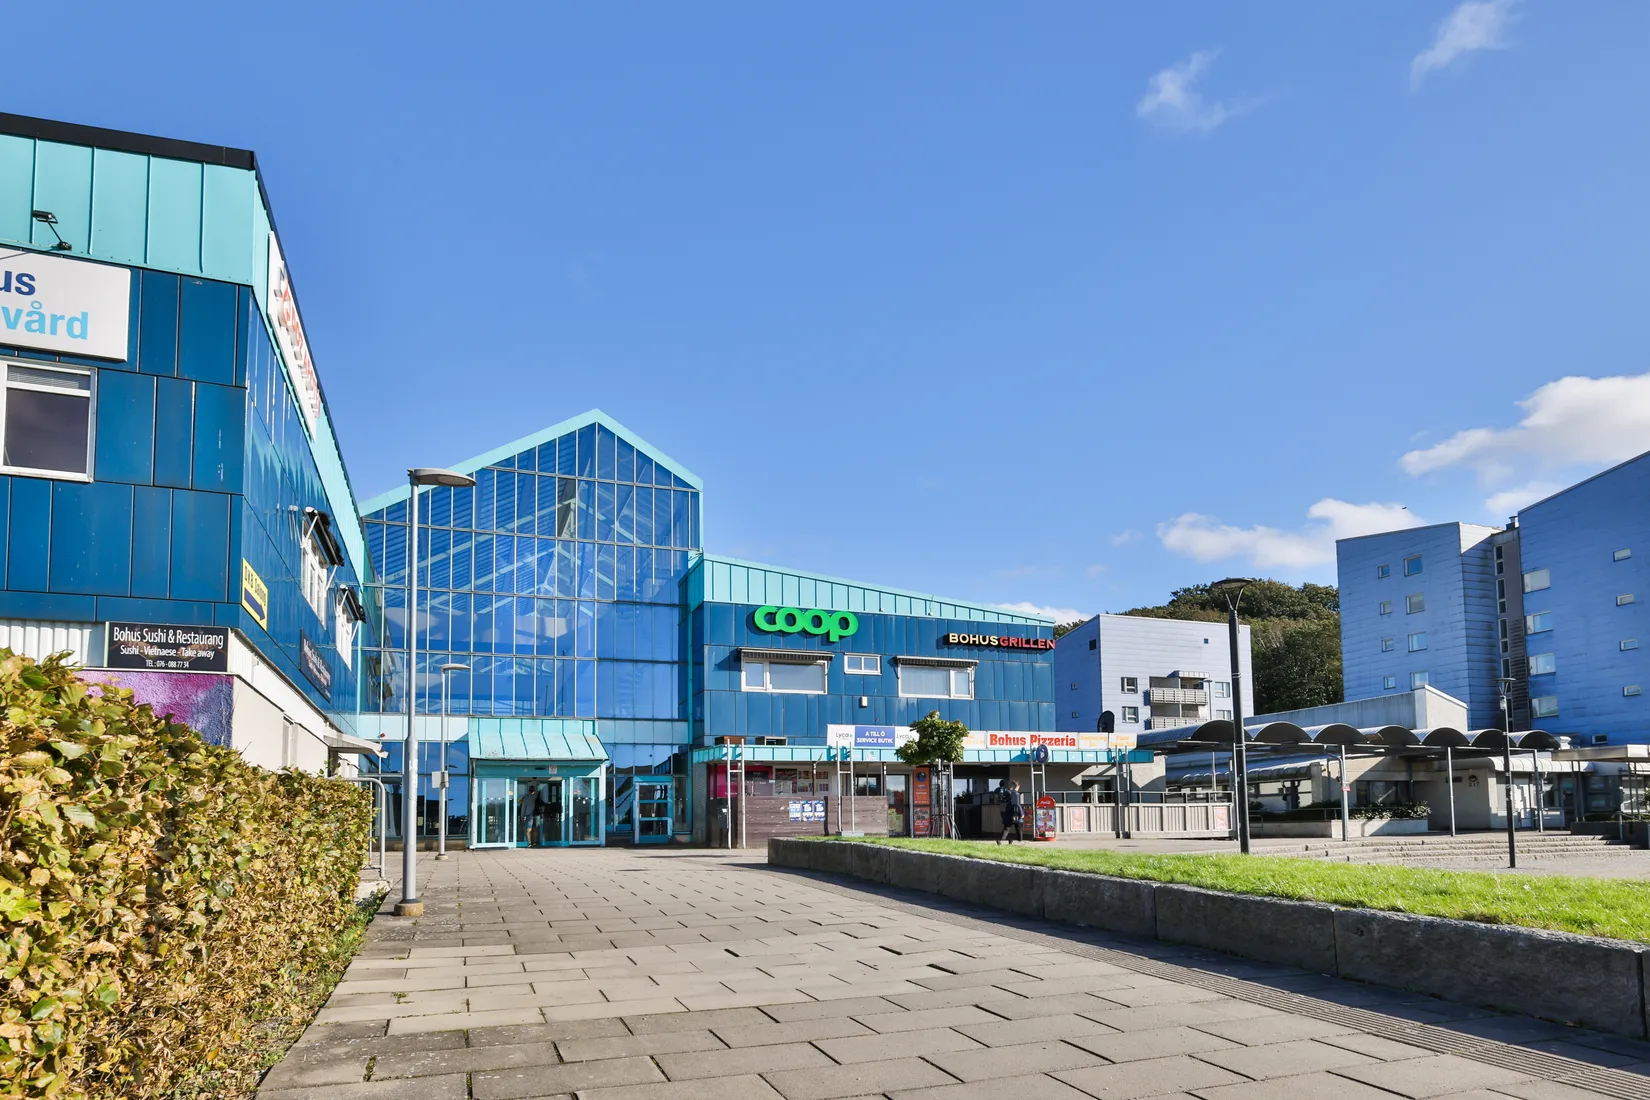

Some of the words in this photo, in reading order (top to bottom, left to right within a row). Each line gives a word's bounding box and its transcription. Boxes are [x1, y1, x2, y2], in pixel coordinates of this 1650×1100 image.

[1, 300, 89, 340] vård
[754, 605, 859, 642] coop
[113, 626, 141, 642] Bohus
[143, 627, 167, 643] Sushi
[167, 630, 175, 643] &
[176, 629, 224, 649] Restaurang
[120, 644, 139, 655] Sushi
[181, 647, 196, 657] Take
[197, 650, 215, 660] away
[989, 733, 1027, 746] Bohus
[1030, 734, 1076, 747] Pizzeria
